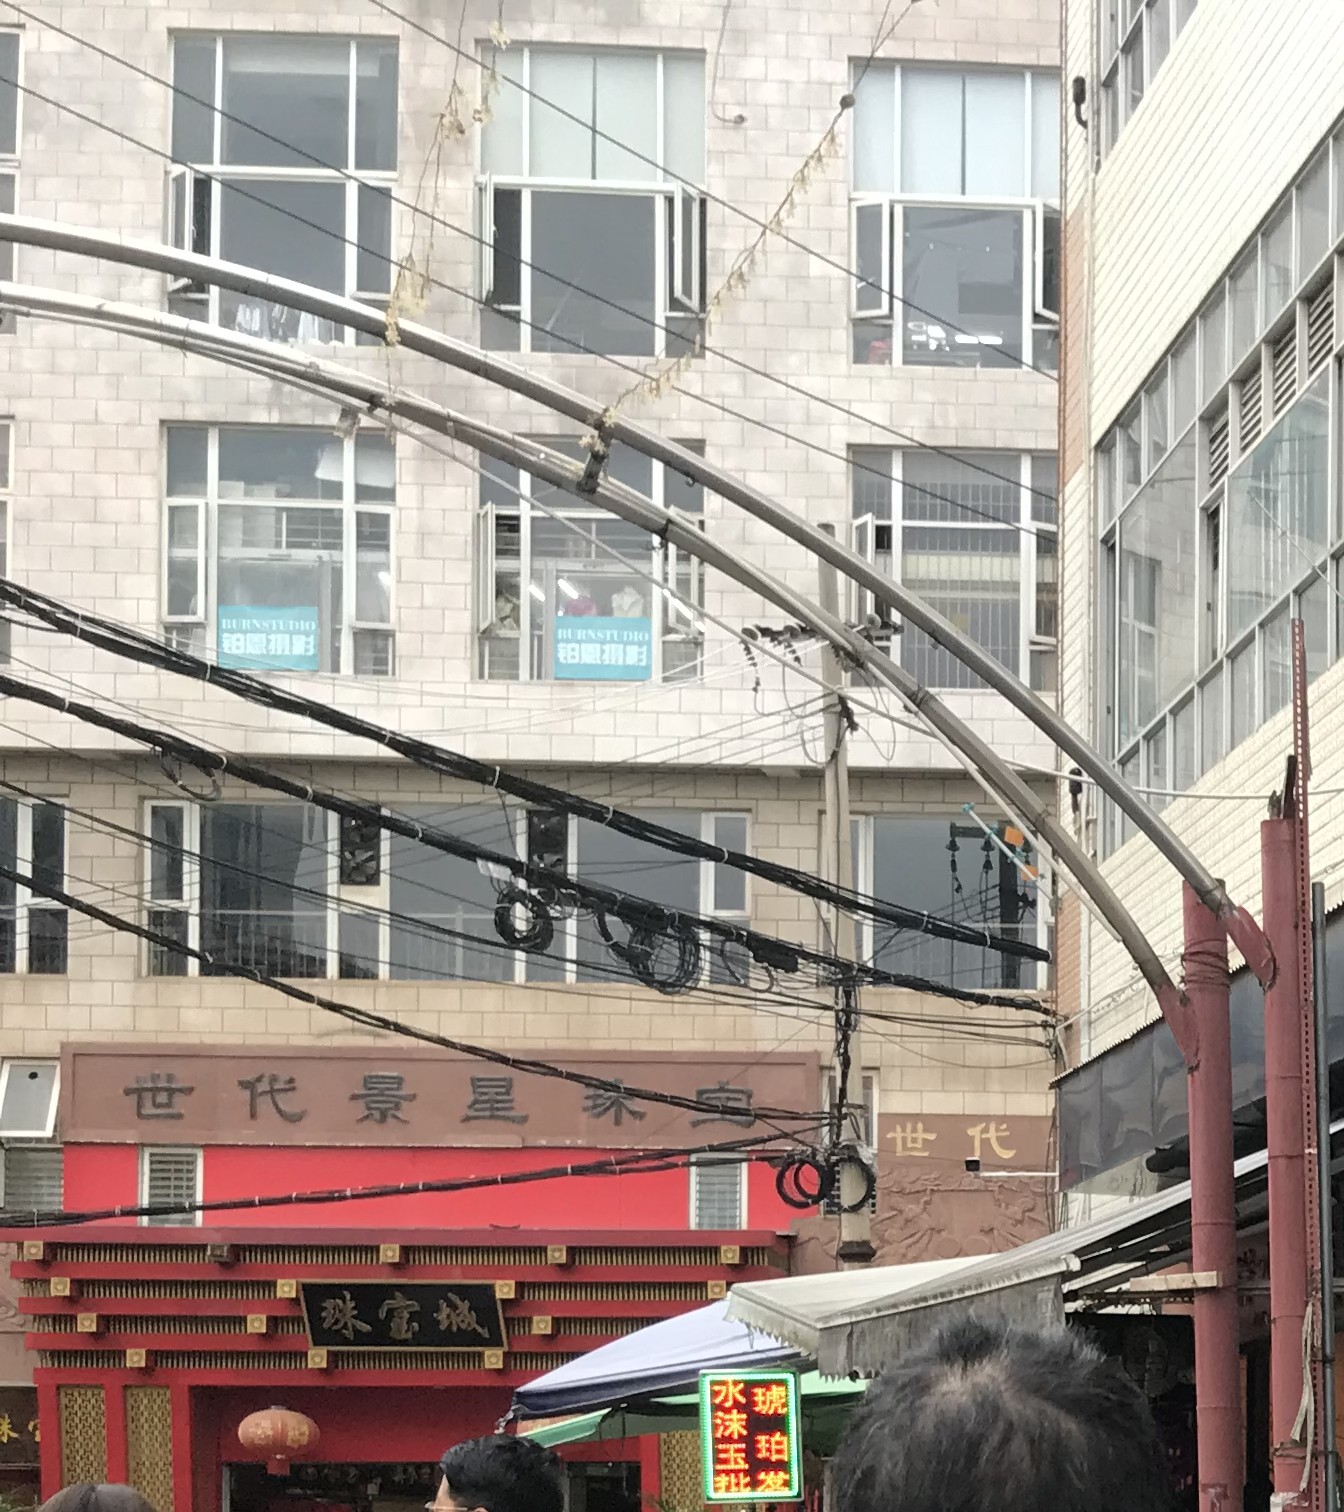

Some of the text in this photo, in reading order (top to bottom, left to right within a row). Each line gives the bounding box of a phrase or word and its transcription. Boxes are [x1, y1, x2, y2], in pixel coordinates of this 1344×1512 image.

[123, 1071, 757, 1130] 世代景星珠宝
[886, 1120, 1016, 1160] 世代
[320, 1290, 491, 1342] 珠宝城
